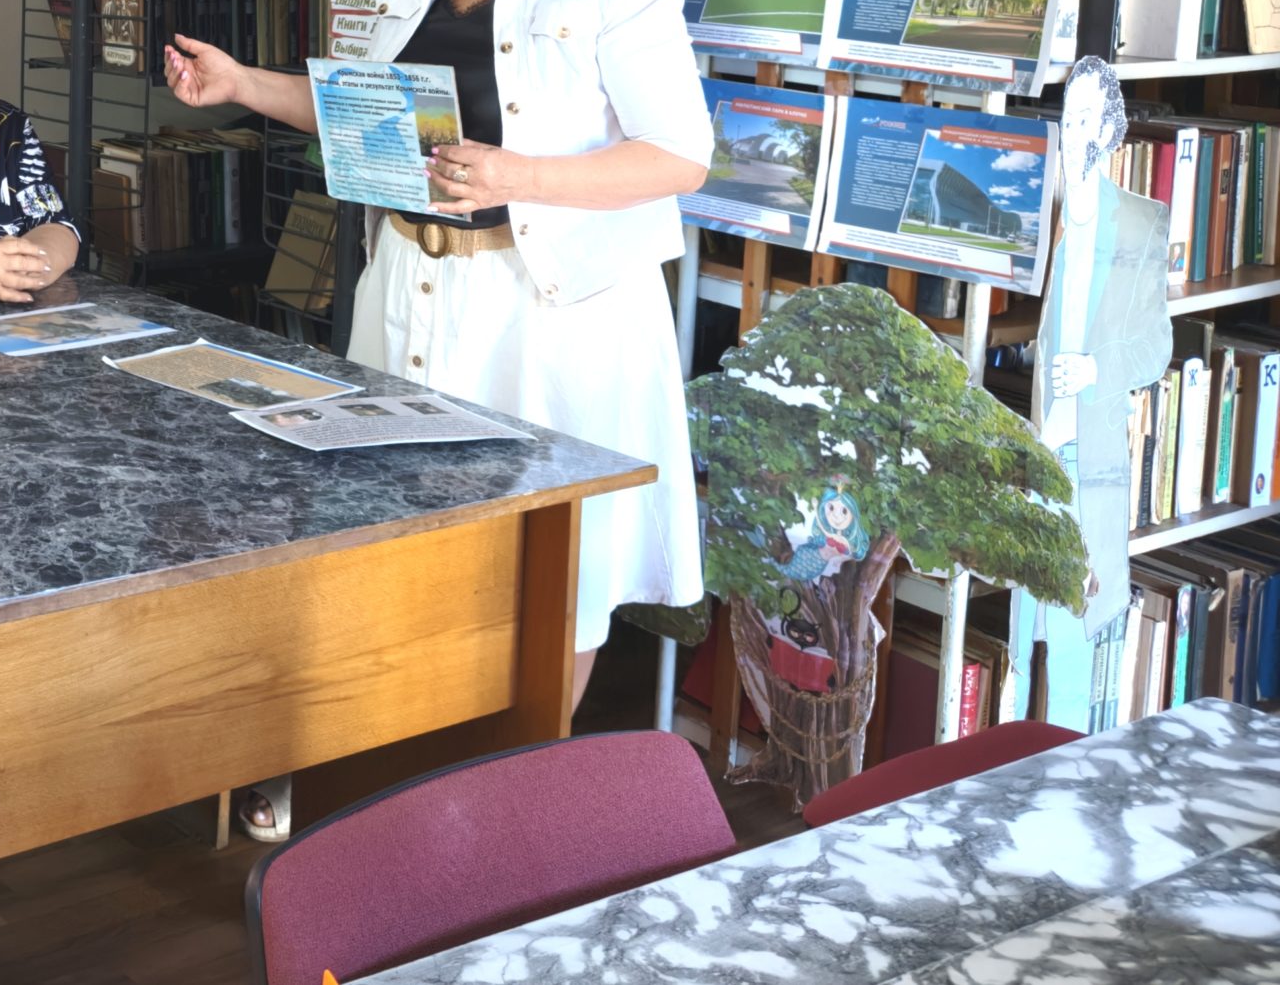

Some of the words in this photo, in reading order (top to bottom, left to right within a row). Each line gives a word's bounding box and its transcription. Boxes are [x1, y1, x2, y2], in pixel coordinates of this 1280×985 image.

[337, 17, 367, 31] Книги
[334, 41, 368, 58] Выбира
[337, 70, 366, 79] Крымская
[367, 71, 385, 80] война
[342, 81, 359, 89] этапы
[365, 82, 395, 92] результат
[395, 84, 427, 94] Крымской
[1179, 138, 1194, 164] Д
[1187, 368, 1198, 387] Ж
[1263, 364, 1278, 387] К
